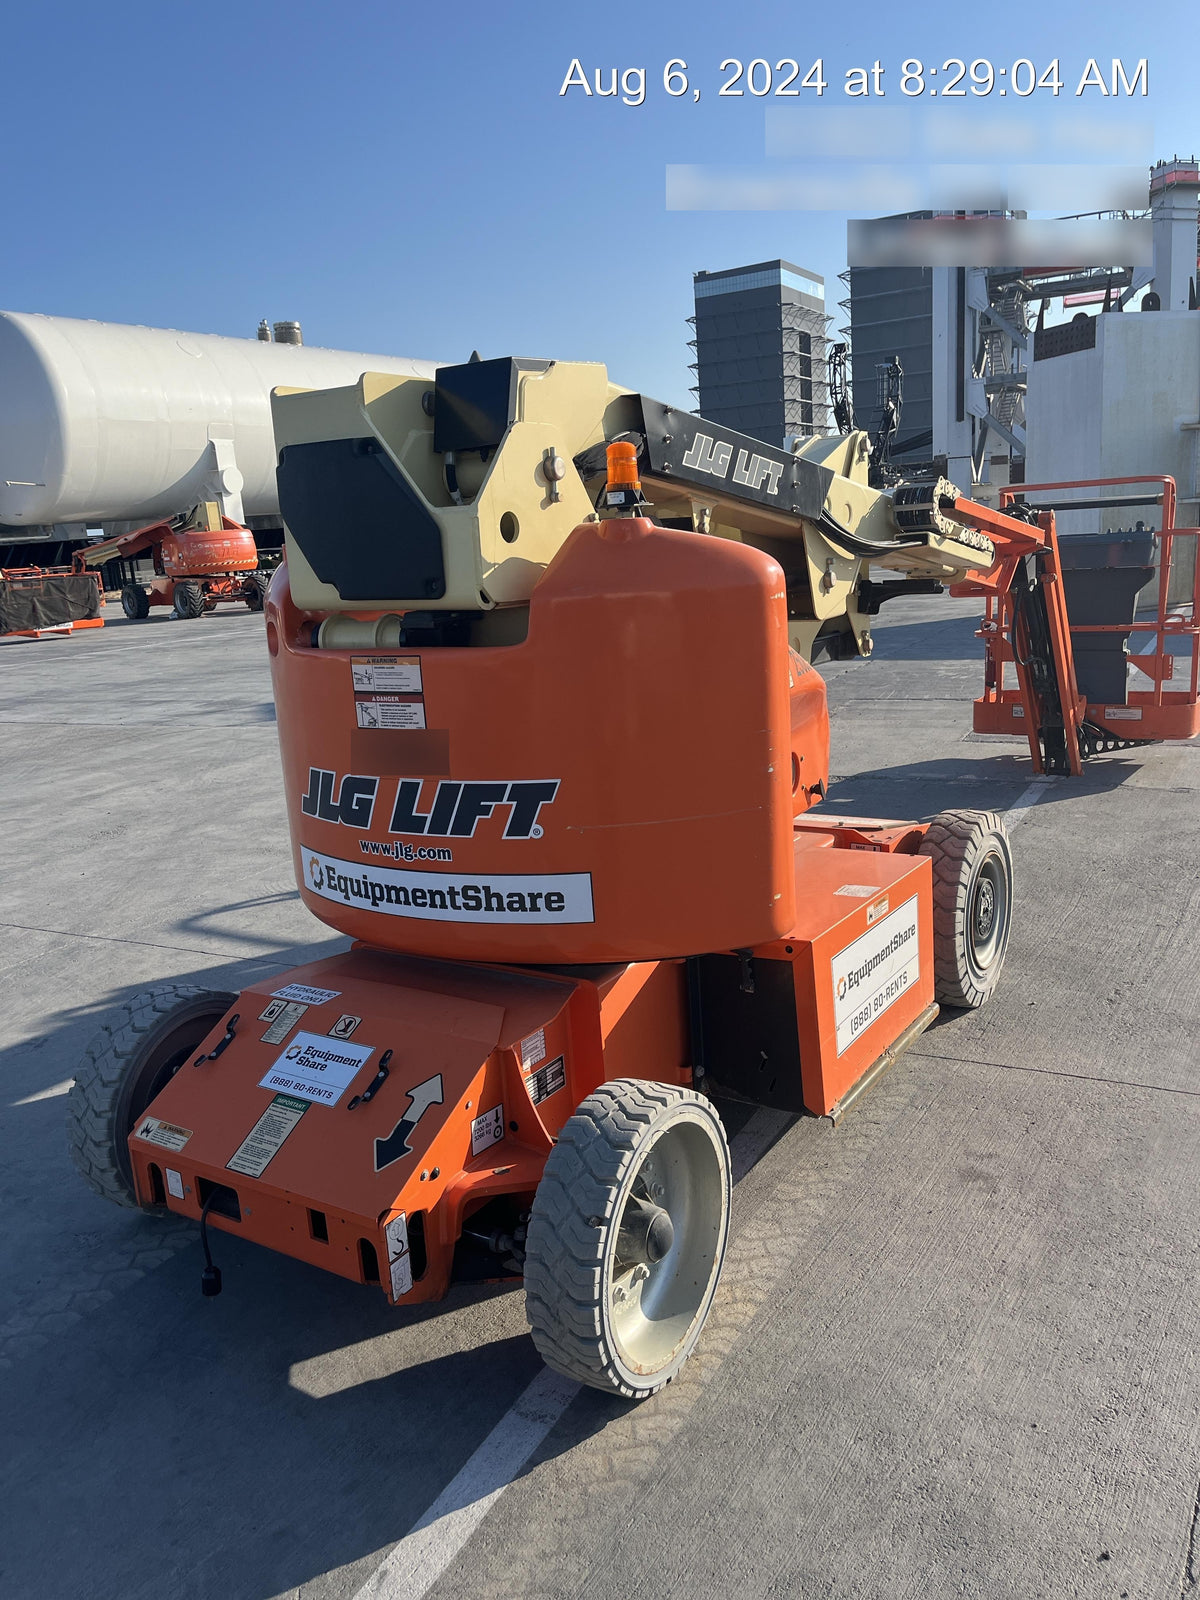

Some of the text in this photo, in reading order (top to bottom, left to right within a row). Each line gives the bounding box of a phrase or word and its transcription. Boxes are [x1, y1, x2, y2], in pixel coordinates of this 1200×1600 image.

[682, 432, 785, 495] JLG LIFT
[301, 766, 381, 830] JLG
[359, 839, 453, 862] www.jlg.com
[324, 864, 566, 914] EquipmentShare
[847, 923, 917, 991] EquipmentShare
[275, 990, 328, 1004] FLUID ONLY
[286, 984, 337, 999] HYDRAULIC
[850, 1002, 872, 1035] (888)
[296, 1056, 328, 1072] Share
[303, 1045, 363, 1068] Equipment
[269, 1075, 294, 1089] (888)
[276, 1097, 307, 1111] IMPORTANT
